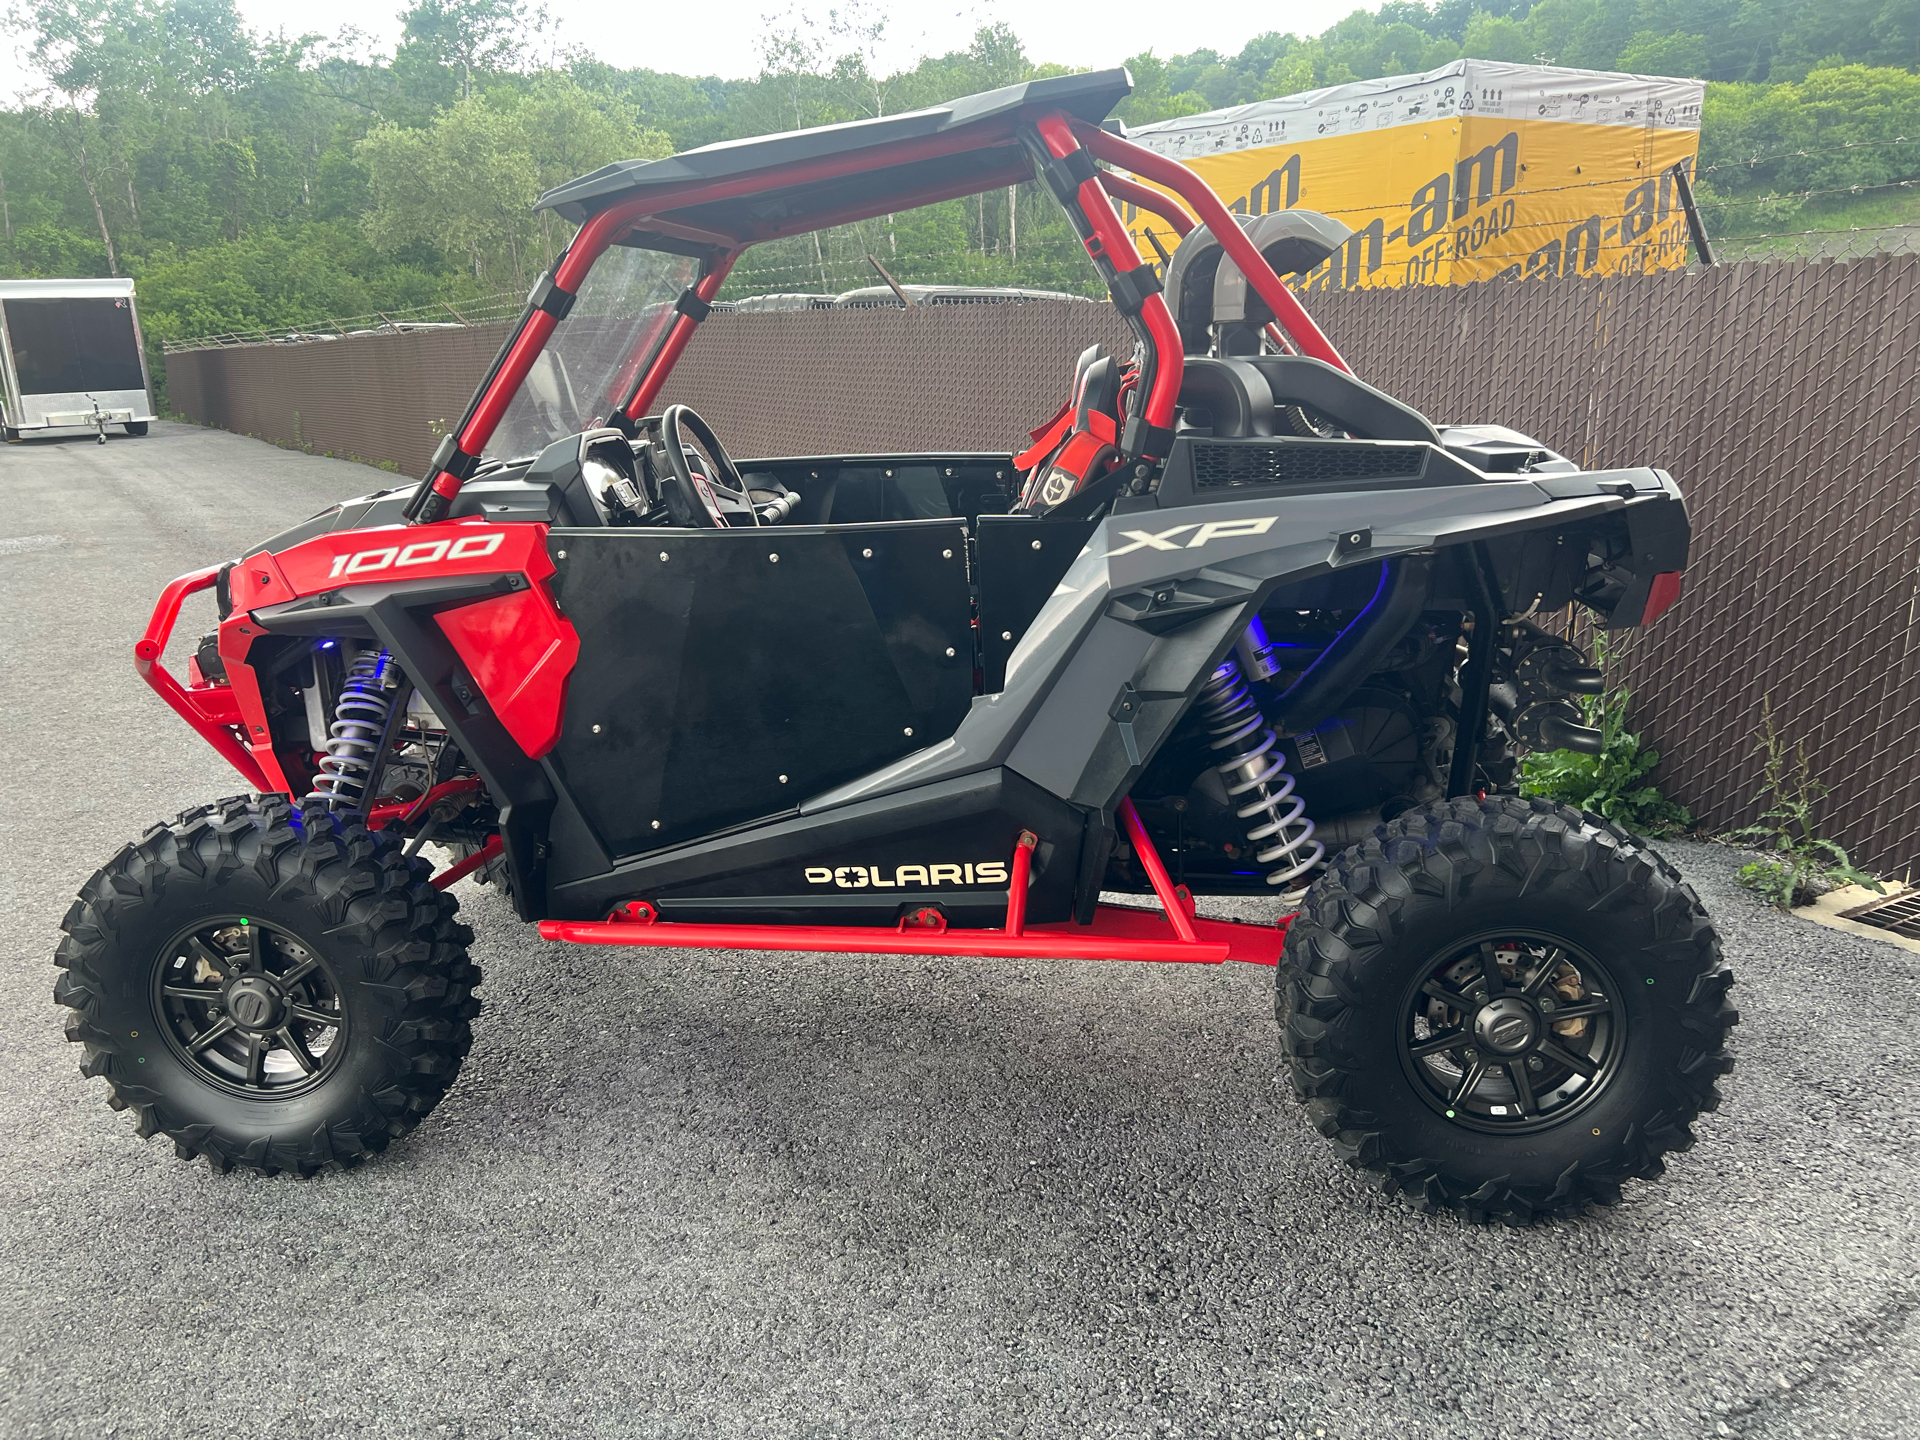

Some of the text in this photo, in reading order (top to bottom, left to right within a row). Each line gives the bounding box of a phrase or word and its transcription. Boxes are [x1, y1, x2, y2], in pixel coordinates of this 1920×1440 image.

[328, 532, 506, 579] 1000
[1095, 516, 1280, 559] XP
[804, 861, 1009, 888] POLARIS
